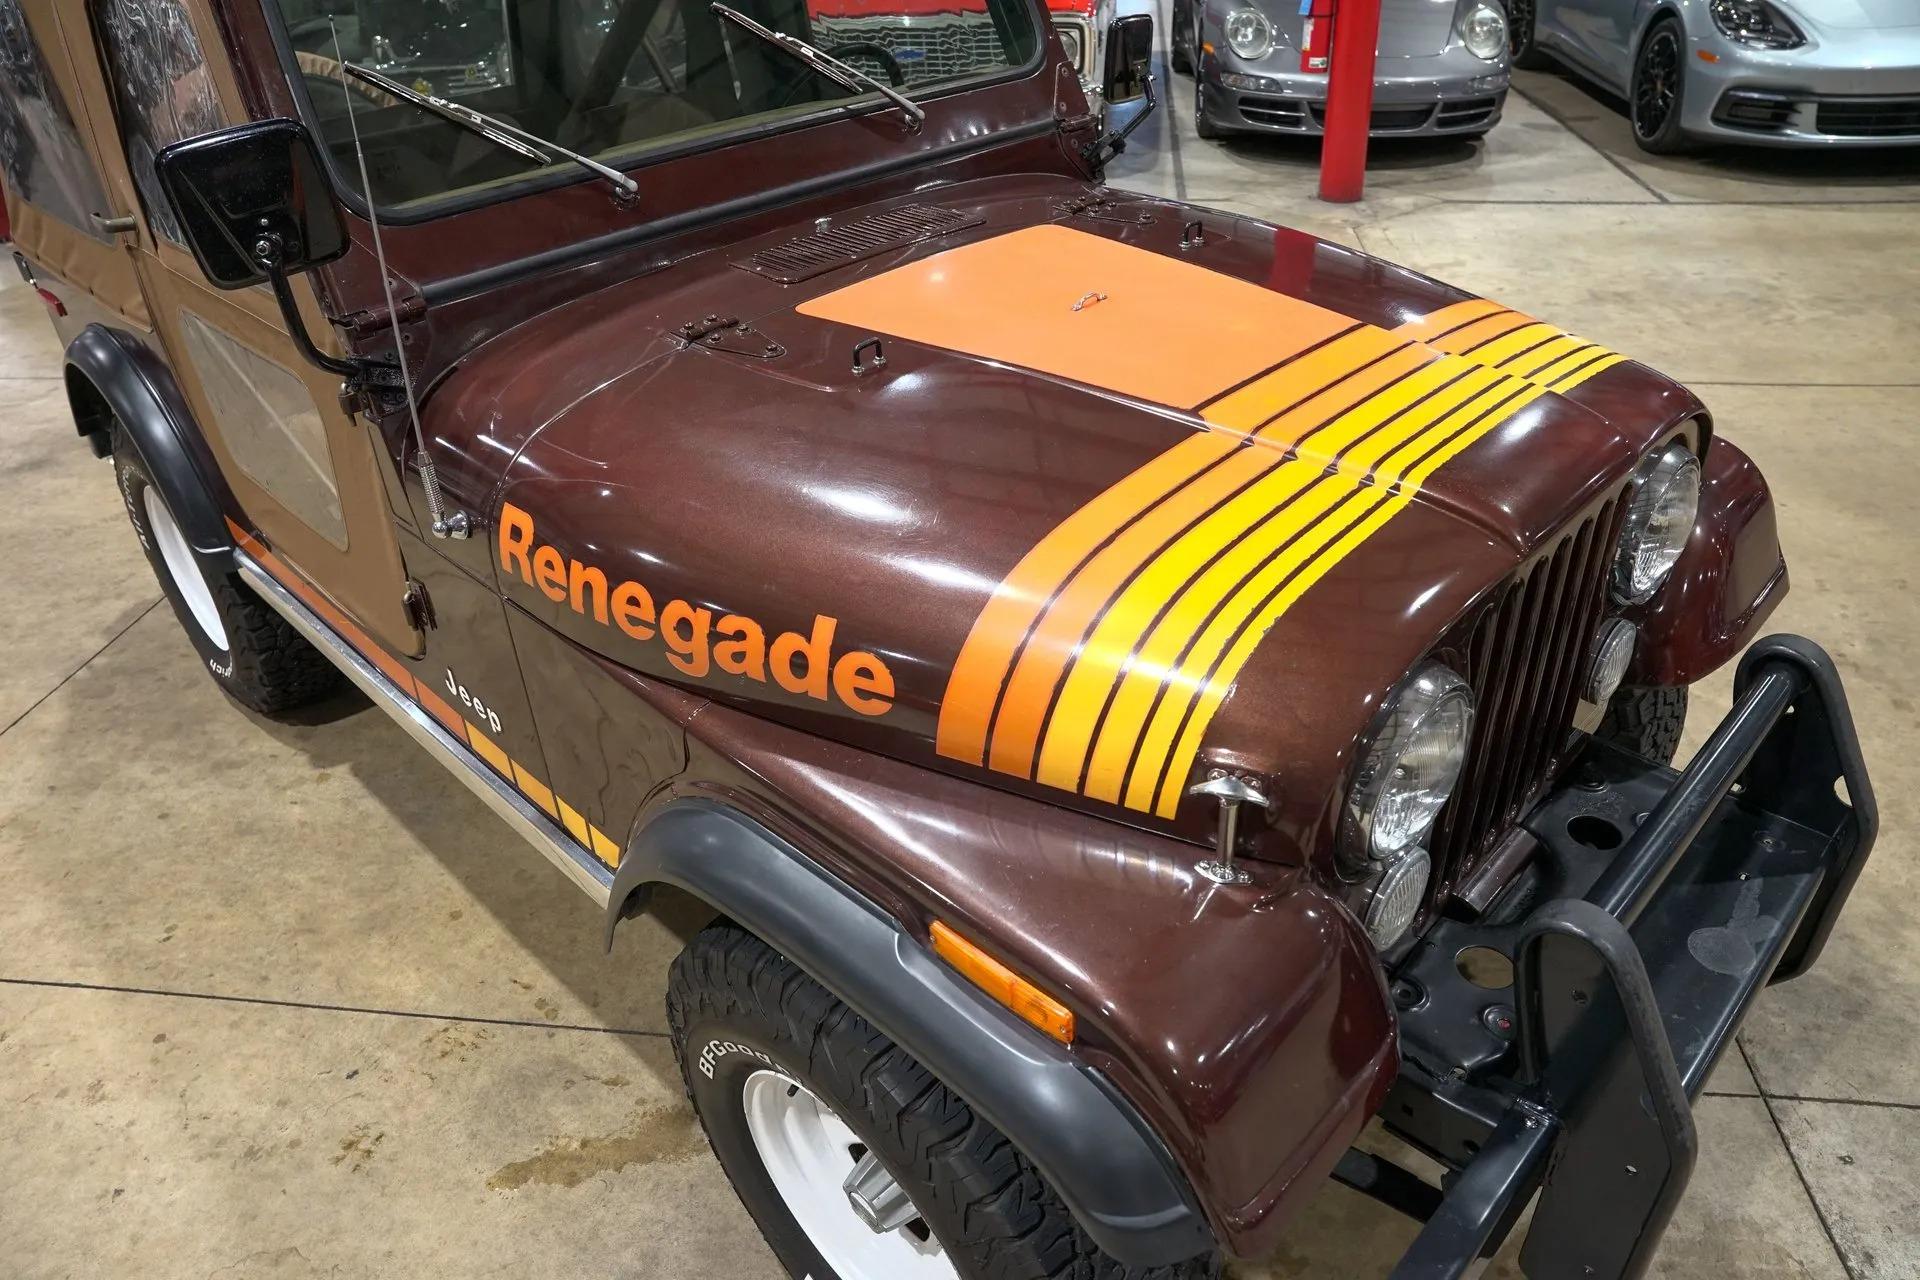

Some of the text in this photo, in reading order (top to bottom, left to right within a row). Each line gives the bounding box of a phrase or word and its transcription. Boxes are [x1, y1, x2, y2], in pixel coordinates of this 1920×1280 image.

[499, 501, 896, 716] Renegade
[445, 668, 502, 733] Jeep
[699, 1039, 803, 1086] BFGood
